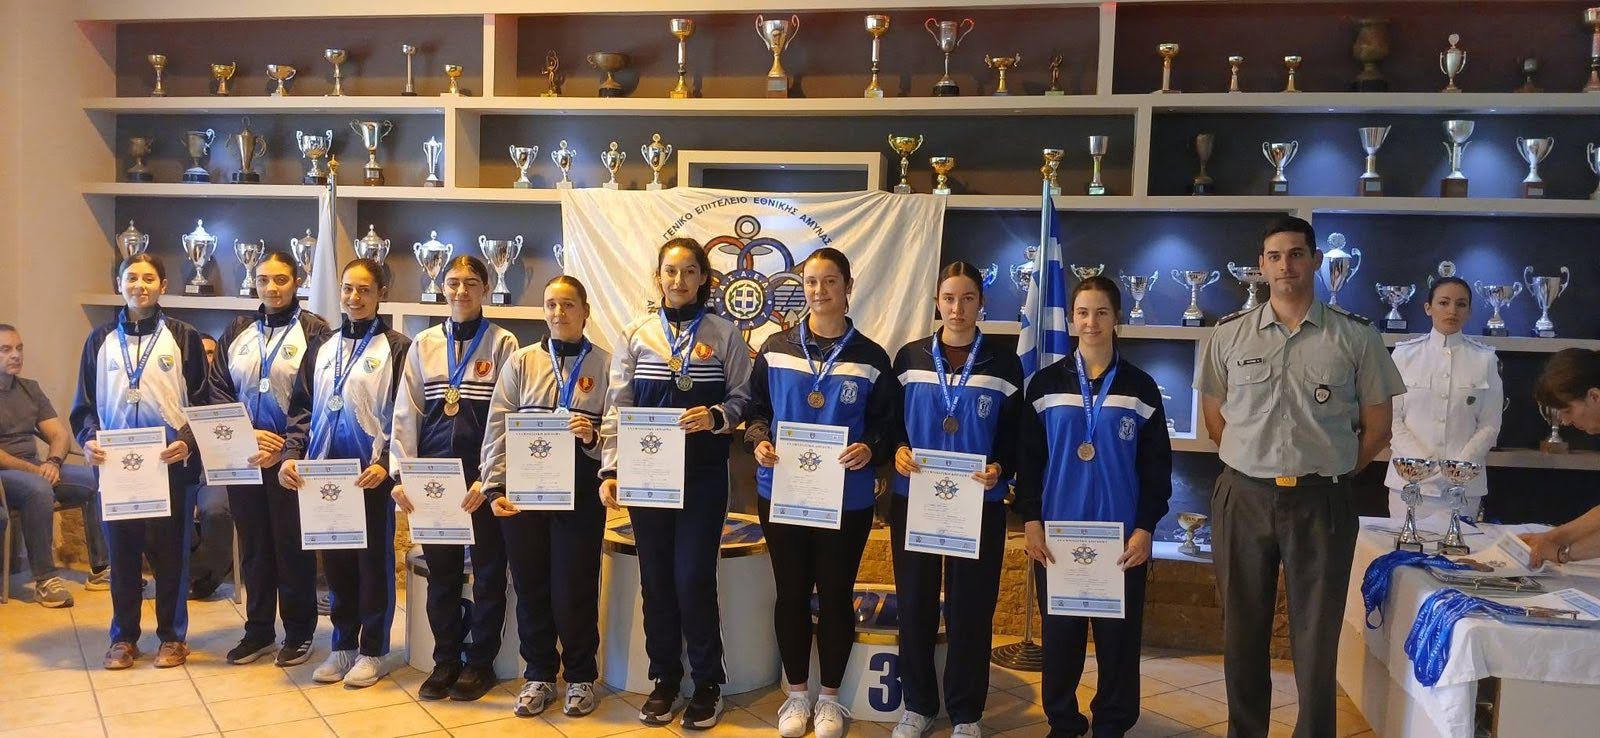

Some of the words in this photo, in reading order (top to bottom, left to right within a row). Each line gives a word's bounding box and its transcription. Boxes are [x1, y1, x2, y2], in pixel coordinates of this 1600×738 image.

[662, 212, 693, 241] ΓΕΝΙΚΟ
[694, 196, 748, 215] ΕΠΙΤΕΛΕΙΟ
[753, 197, 799, 216] ΕΘΝΙΚΗΣ
[799, 214, 833, 246] ΑΜΥΝΑΣ
[868, 652, 903, 713] 3
